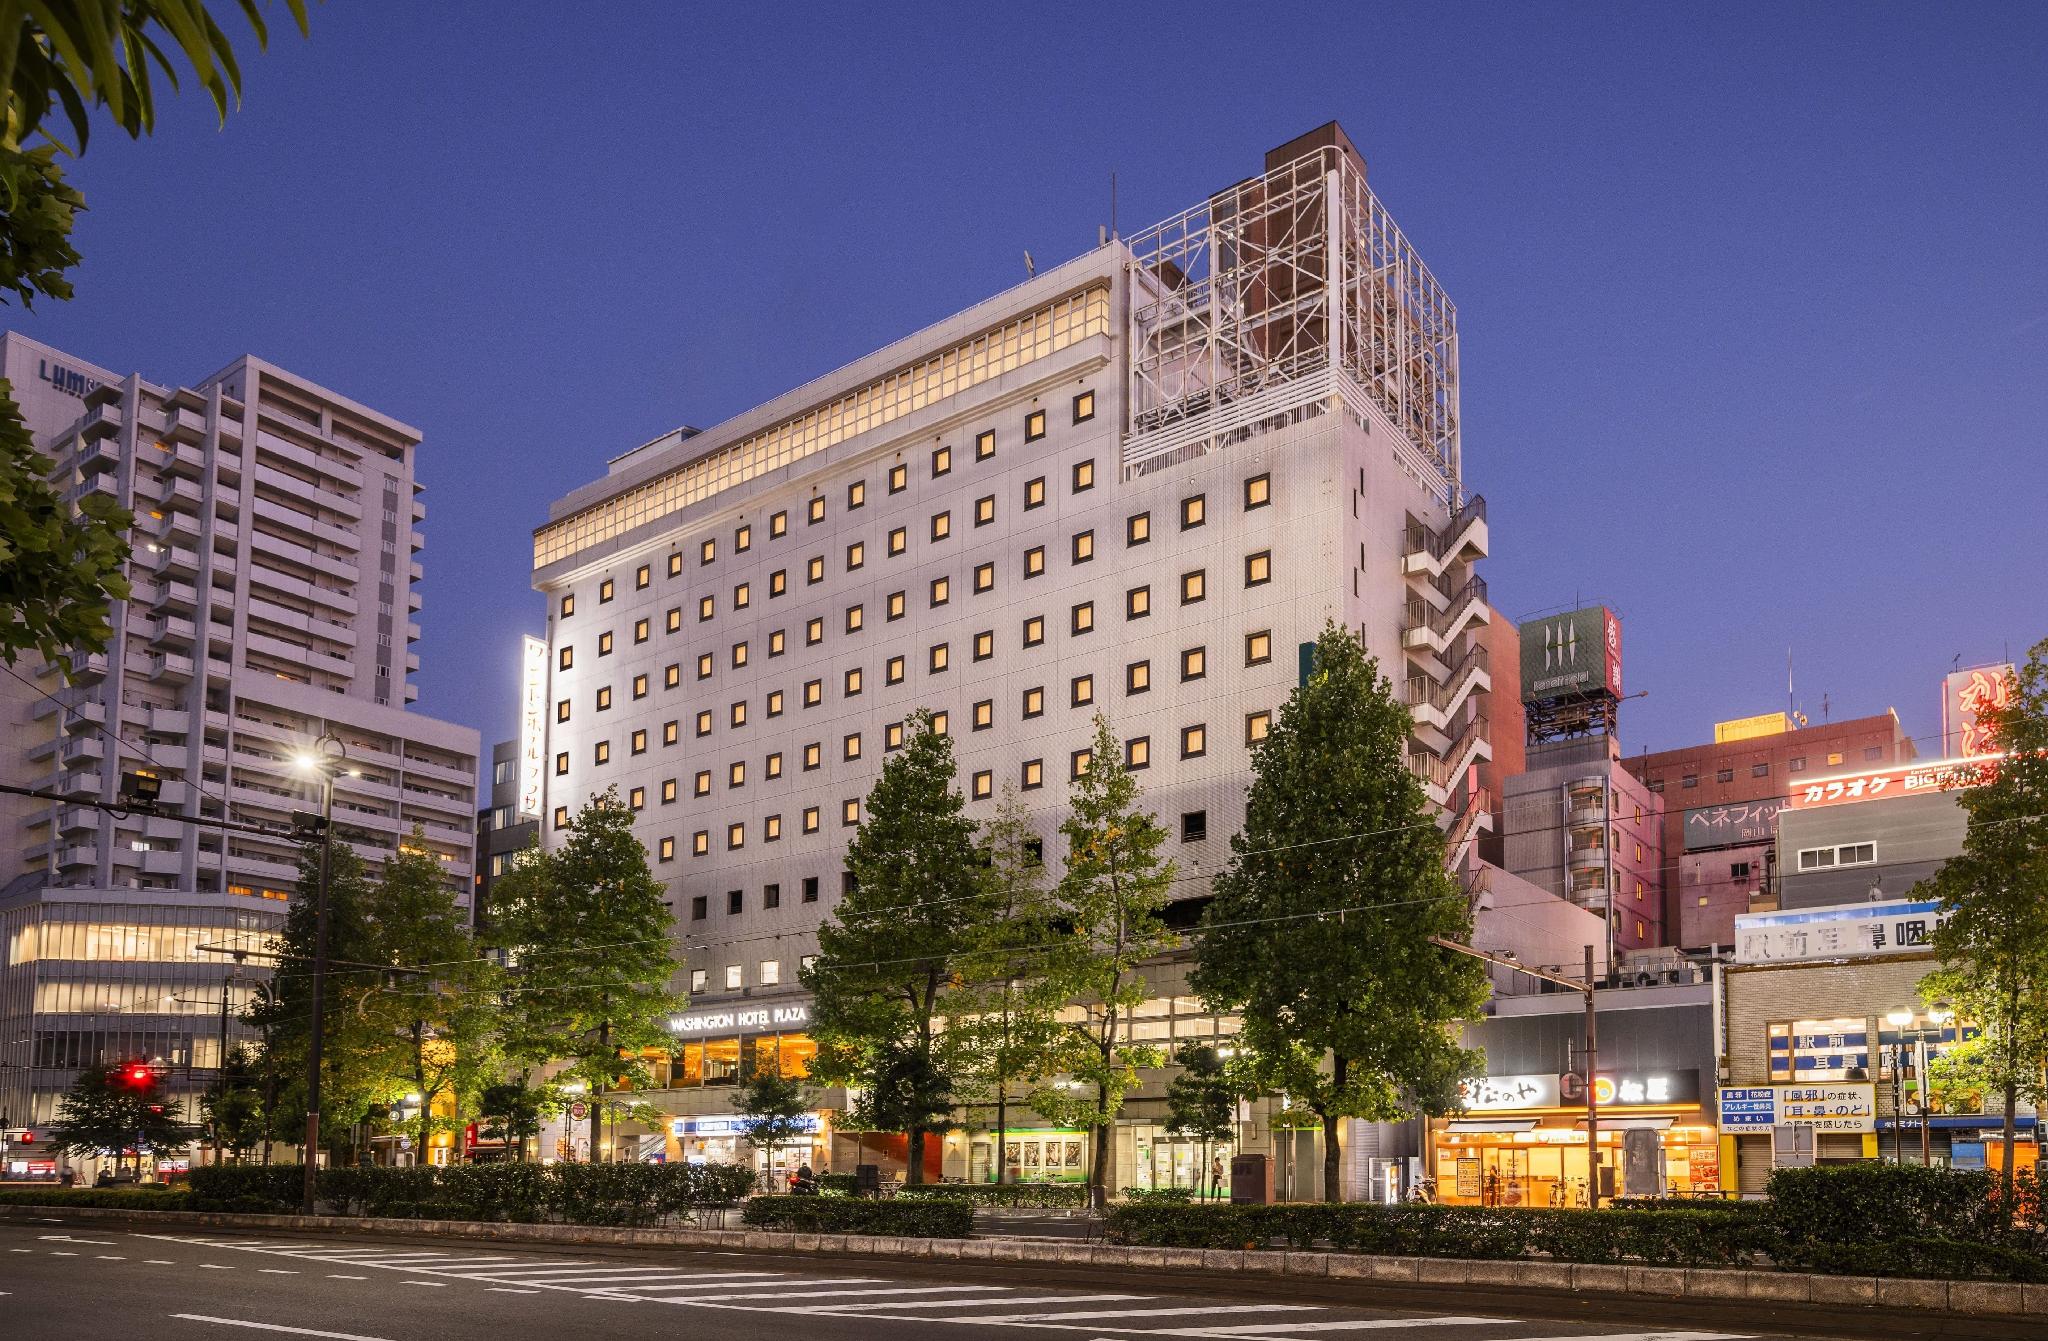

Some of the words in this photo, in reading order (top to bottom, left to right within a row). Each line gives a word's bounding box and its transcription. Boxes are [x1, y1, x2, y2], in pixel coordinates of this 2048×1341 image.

[1804, 776, 1890, 803] カラオケ
[671, 1013, 734, 1031] WASHINGTON
[738, 1010, 769, 1025] HOTEL
[774, 1008, 806, 1022] PLAZA
[1799, 1034, 1845, 1049] 駅前
